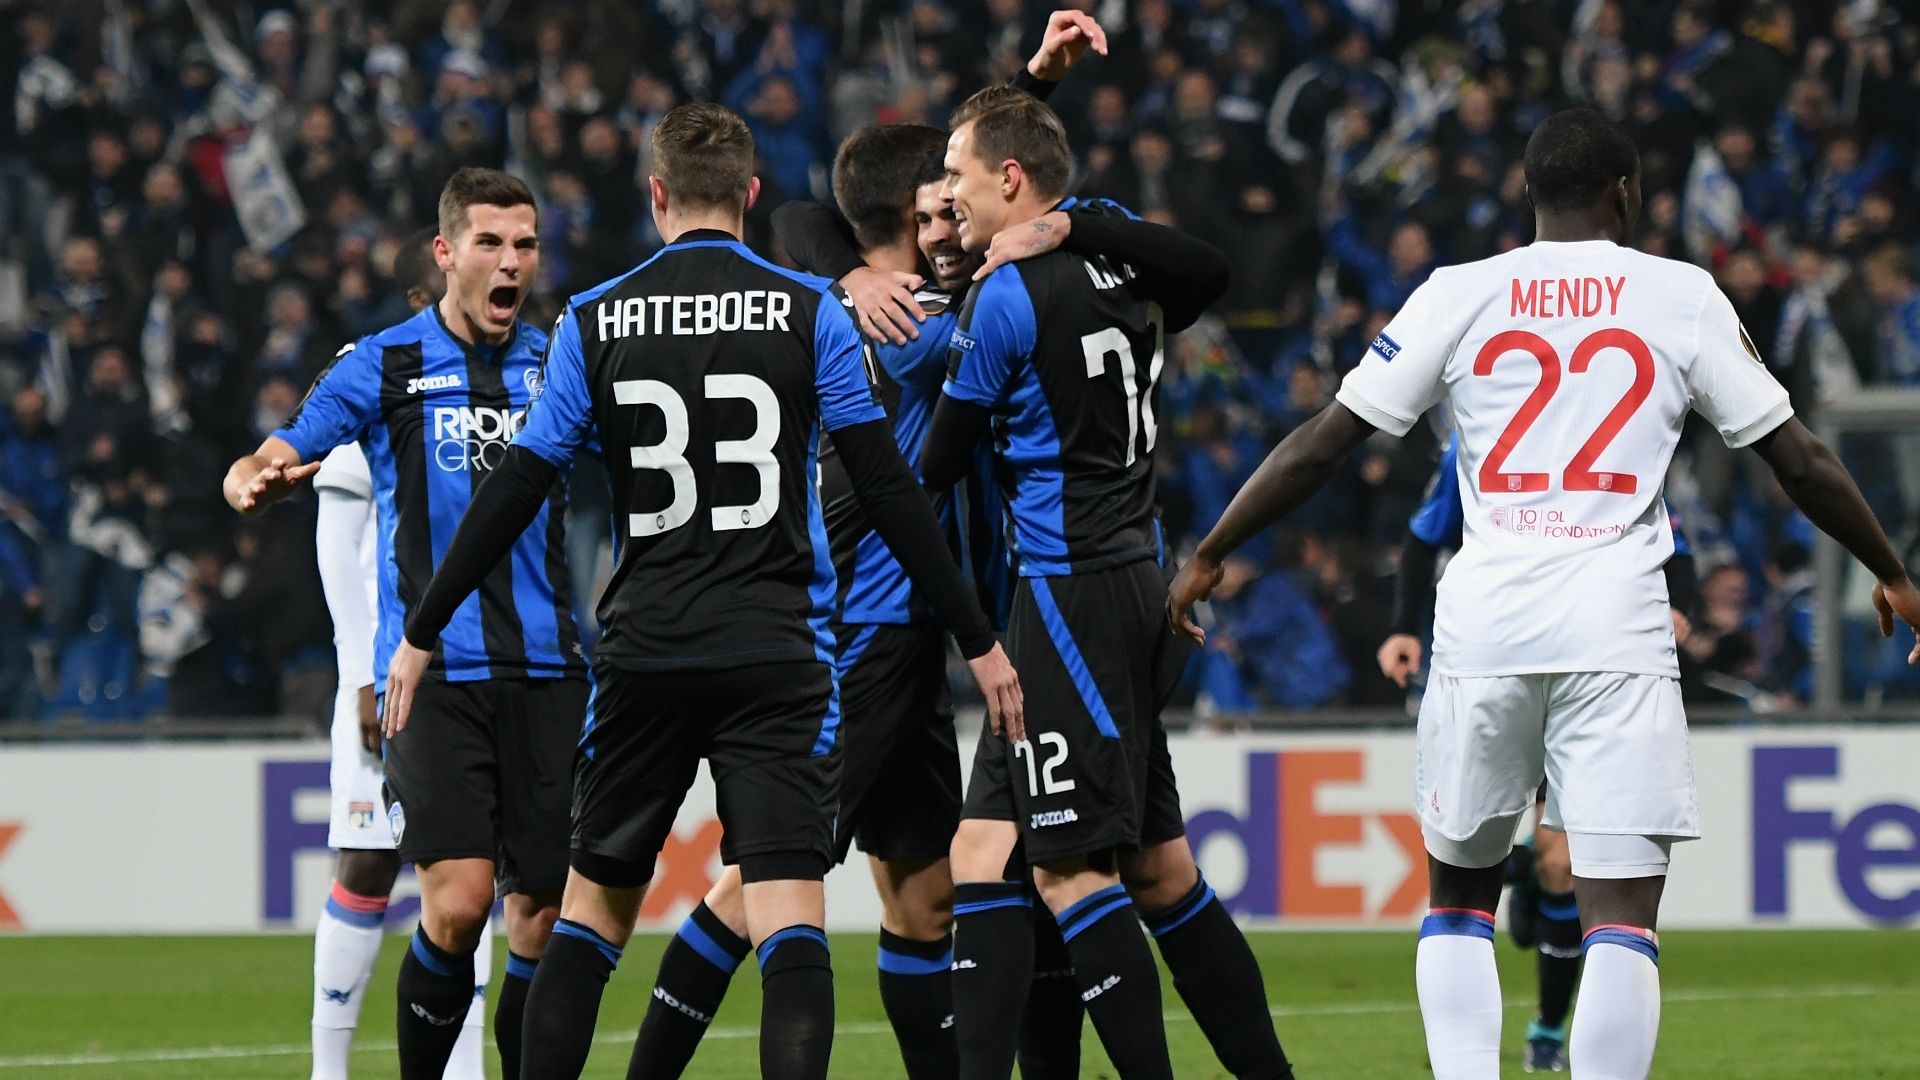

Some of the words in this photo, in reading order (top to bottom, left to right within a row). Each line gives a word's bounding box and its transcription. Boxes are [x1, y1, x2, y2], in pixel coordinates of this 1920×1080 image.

[1510, 276, 1626, 318] MENDY
[598, 290, 791, 341] HATEBOER
[1372, 335, 1398, 358] SPECT
[1473, 328, 1655, 494] 22
[613, 373, 781, 537] 33
[1518, 509, 1537, 525] 10
[1544, 523, 1626, 539] FONDATION
[1547, 510, 1565, 522] OL
